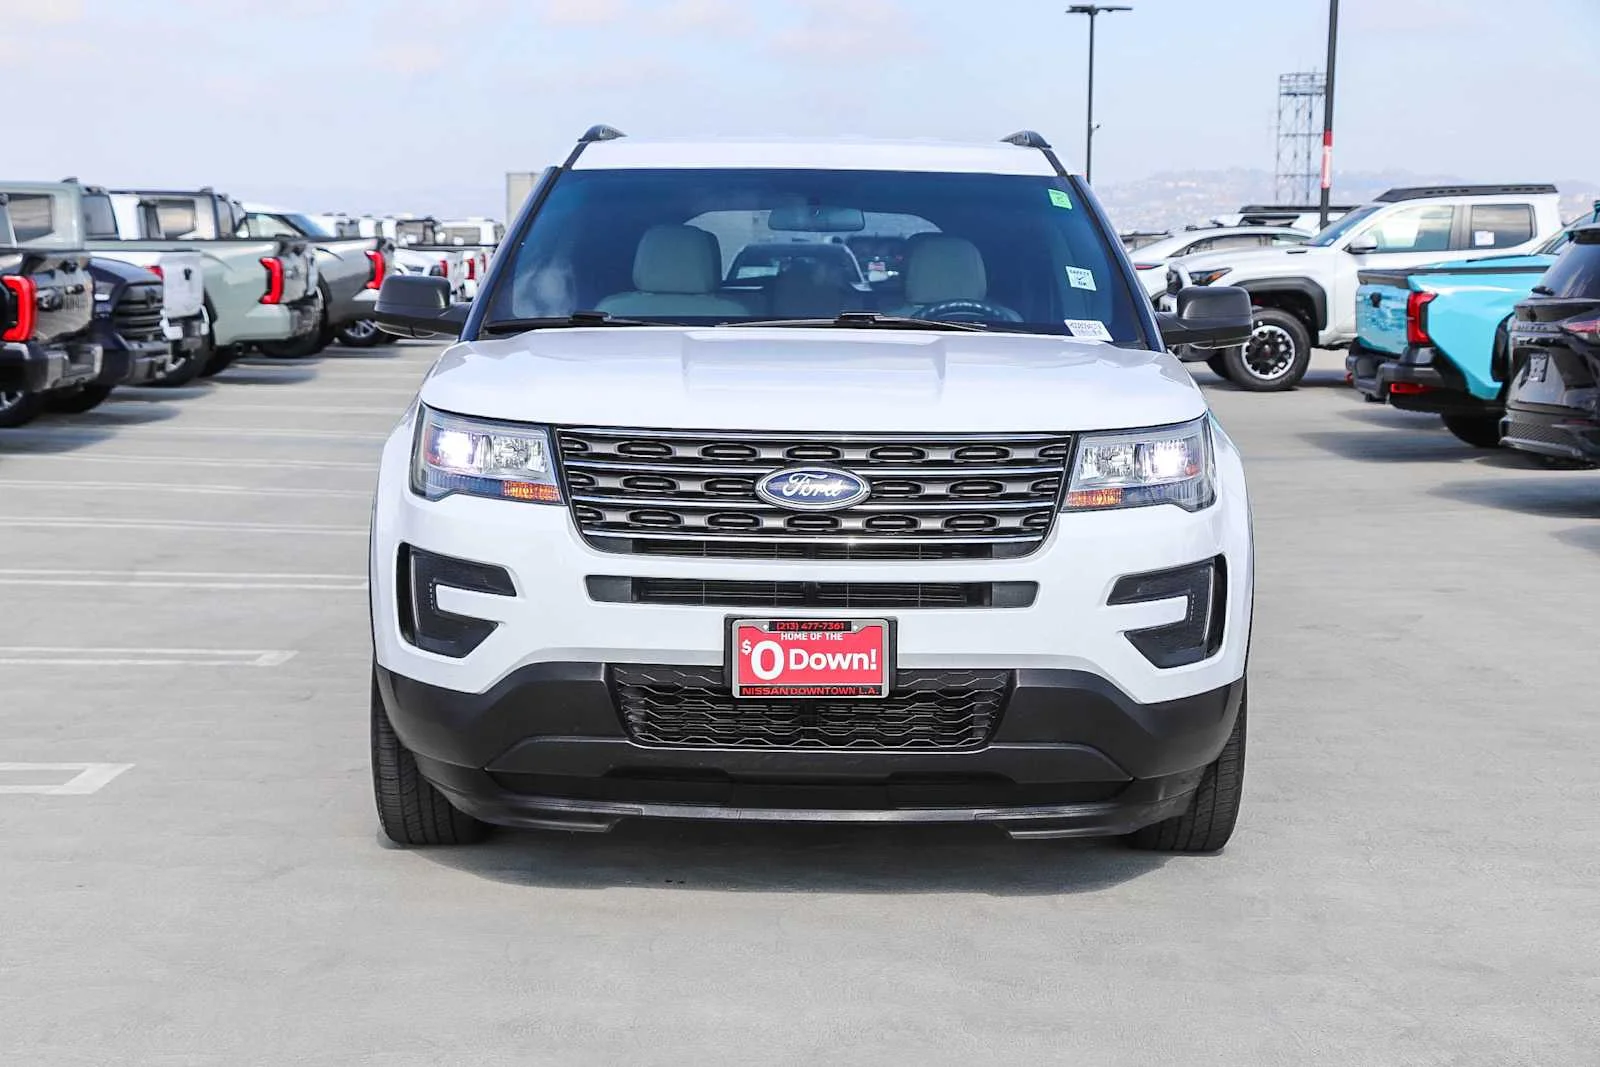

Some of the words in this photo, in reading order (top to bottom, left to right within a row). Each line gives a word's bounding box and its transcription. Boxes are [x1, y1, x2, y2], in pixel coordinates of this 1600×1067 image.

[782, 473, 843, 497] Ford
[777, 622, 799, 632] (213)
[781, 631, 808, 641] HOME
[810, 631, 823, 641] OF
[825, 631, 844, 641] THE
[789, 648, 877, 670] Down!
[742, 687, 788, 696] NISSAN
[790, 687, 856, 696] DOWNTOWN
[858, 687, 879, 695] L.A.
